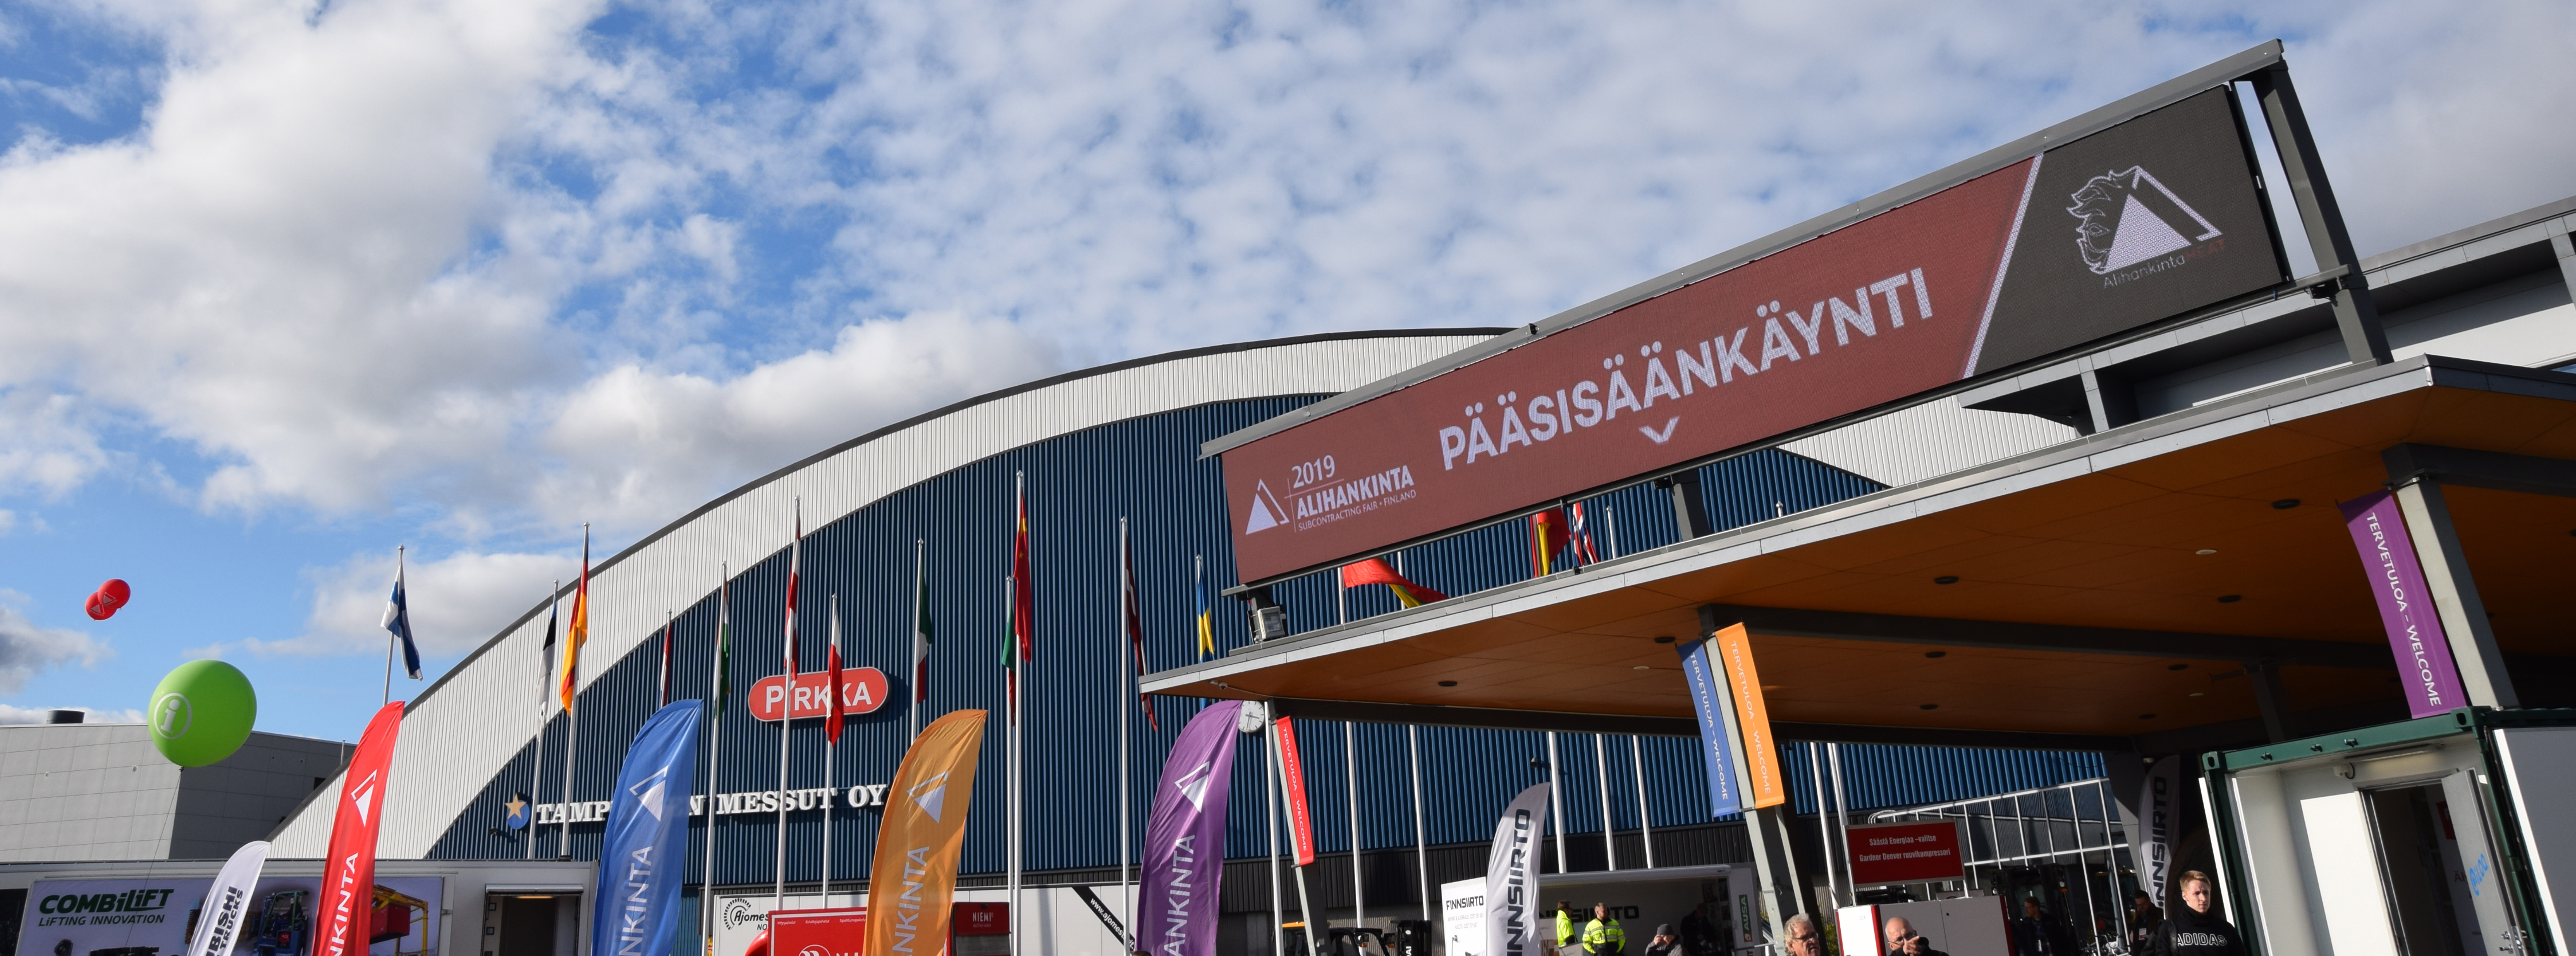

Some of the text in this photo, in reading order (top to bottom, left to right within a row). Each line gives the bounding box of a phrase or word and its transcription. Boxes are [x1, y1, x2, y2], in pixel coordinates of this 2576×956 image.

[1439, 267, 1933, 471] PÄÄSISÄÄNKÄYNTI
[1291, 455, 1336, 489] 2019
[1297, 465, 1414, 519] ALIHANKINTA
[1298, 489, 1416, 531] SUBCONTRACTING FAIR FINLAND
[2366, 512, 2408, 612] TERVETULOA
[2406, 624, 2442, 707] WELCOME
[766, 681, 872, 713] PRKA
[1731, 641, 1754, 720] TERVETULOA
[1753, 730, 1771, 794] WELCOME
[1690, 652, 1714, 728] TERVETULOA
[1713, 738, 1728, 800] WELCOME
[716, 787, 838, 814] MESSUT
[849, 784, 888, 808] OY
[1283, 727, 1297, 792] TERVETULOA
[1296, 800, 1307, 851] WELCOME
[1859, 848, 1950, 862] Gardner Denver ruuvikompressori
[1869, 838, 1888, 846] Säästä
[1890, 836, 1914, 845] Energiaa
[89, 914, 165, 925] INNOVATION
[206, 886, 238, 956] BISHI
[219, 890, 243, 949] TRUCKS
[619, 846, 653, 956] NKINTA
[892, 846, 929, 956] NKINTA
[1446, 895, 1484, 910] FINNSIIRTO
[1741, 896, 1751, 931] AUSA
[2177, 933, 2227, 946] ADIDAS
